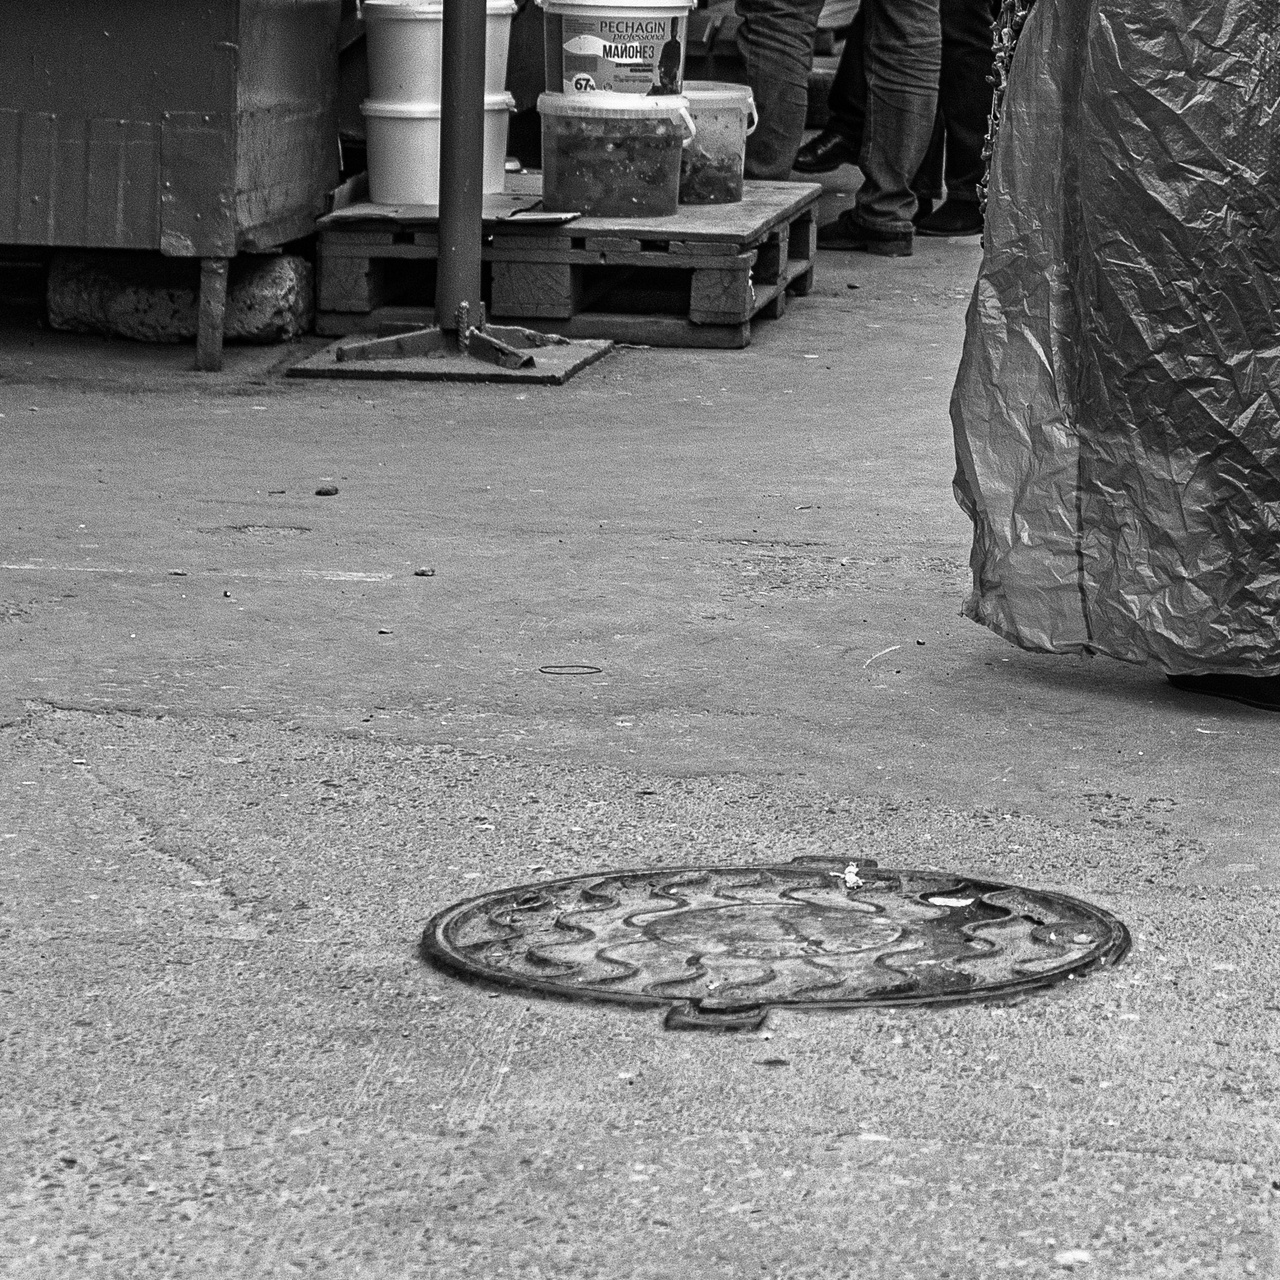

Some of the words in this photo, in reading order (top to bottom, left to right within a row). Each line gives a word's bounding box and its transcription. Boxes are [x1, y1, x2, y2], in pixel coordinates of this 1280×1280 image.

[600, 21, 665, 33] PECHAGIN
[613, 33, 665, 41] professional
[602, 43, 655, 59] МАЙОНЕЗ
